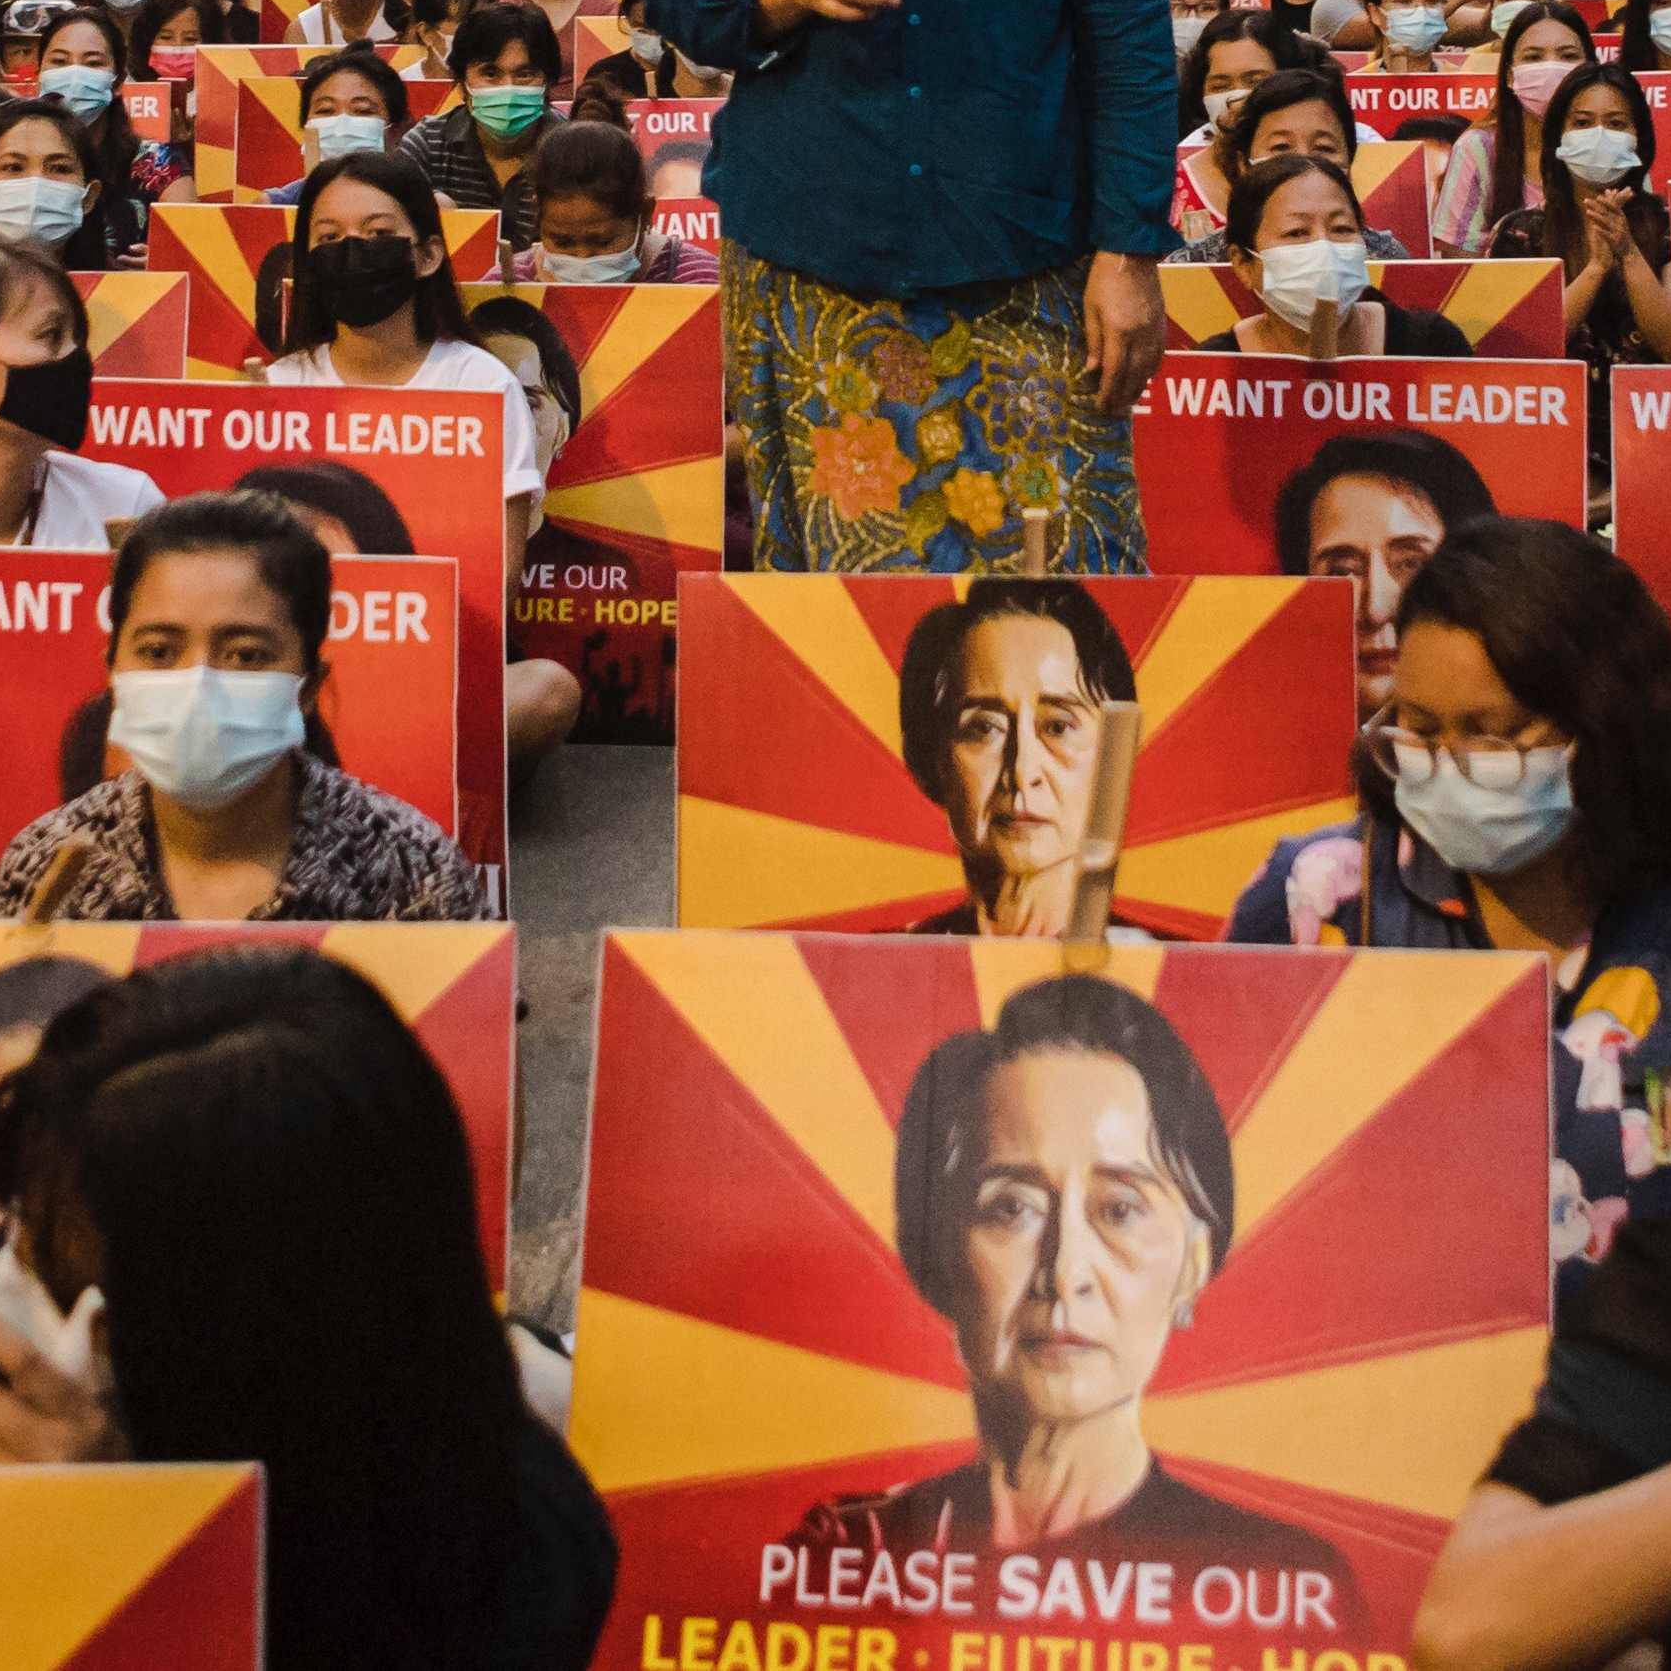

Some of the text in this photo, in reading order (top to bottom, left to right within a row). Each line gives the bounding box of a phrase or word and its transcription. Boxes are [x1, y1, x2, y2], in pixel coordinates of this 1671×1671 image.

[1389, 87, 1440, 110] OUR
[645, 112, 698, 134] OUR
[1165, 377, 1291, 419] WANT
[1302, 380, 1392, 422] OUR
[1406, 383, 1570, 427] LEADER
[89, 403, 487, 458] WANT OUR LEADER
[564, 564, 629, 591] OUR
[593, 598, 678, 627] HOPE
[757, 1544, 1337, 1630] PLEASE SAVE OUR
[641, 1614, 899, 1671] LEADER
